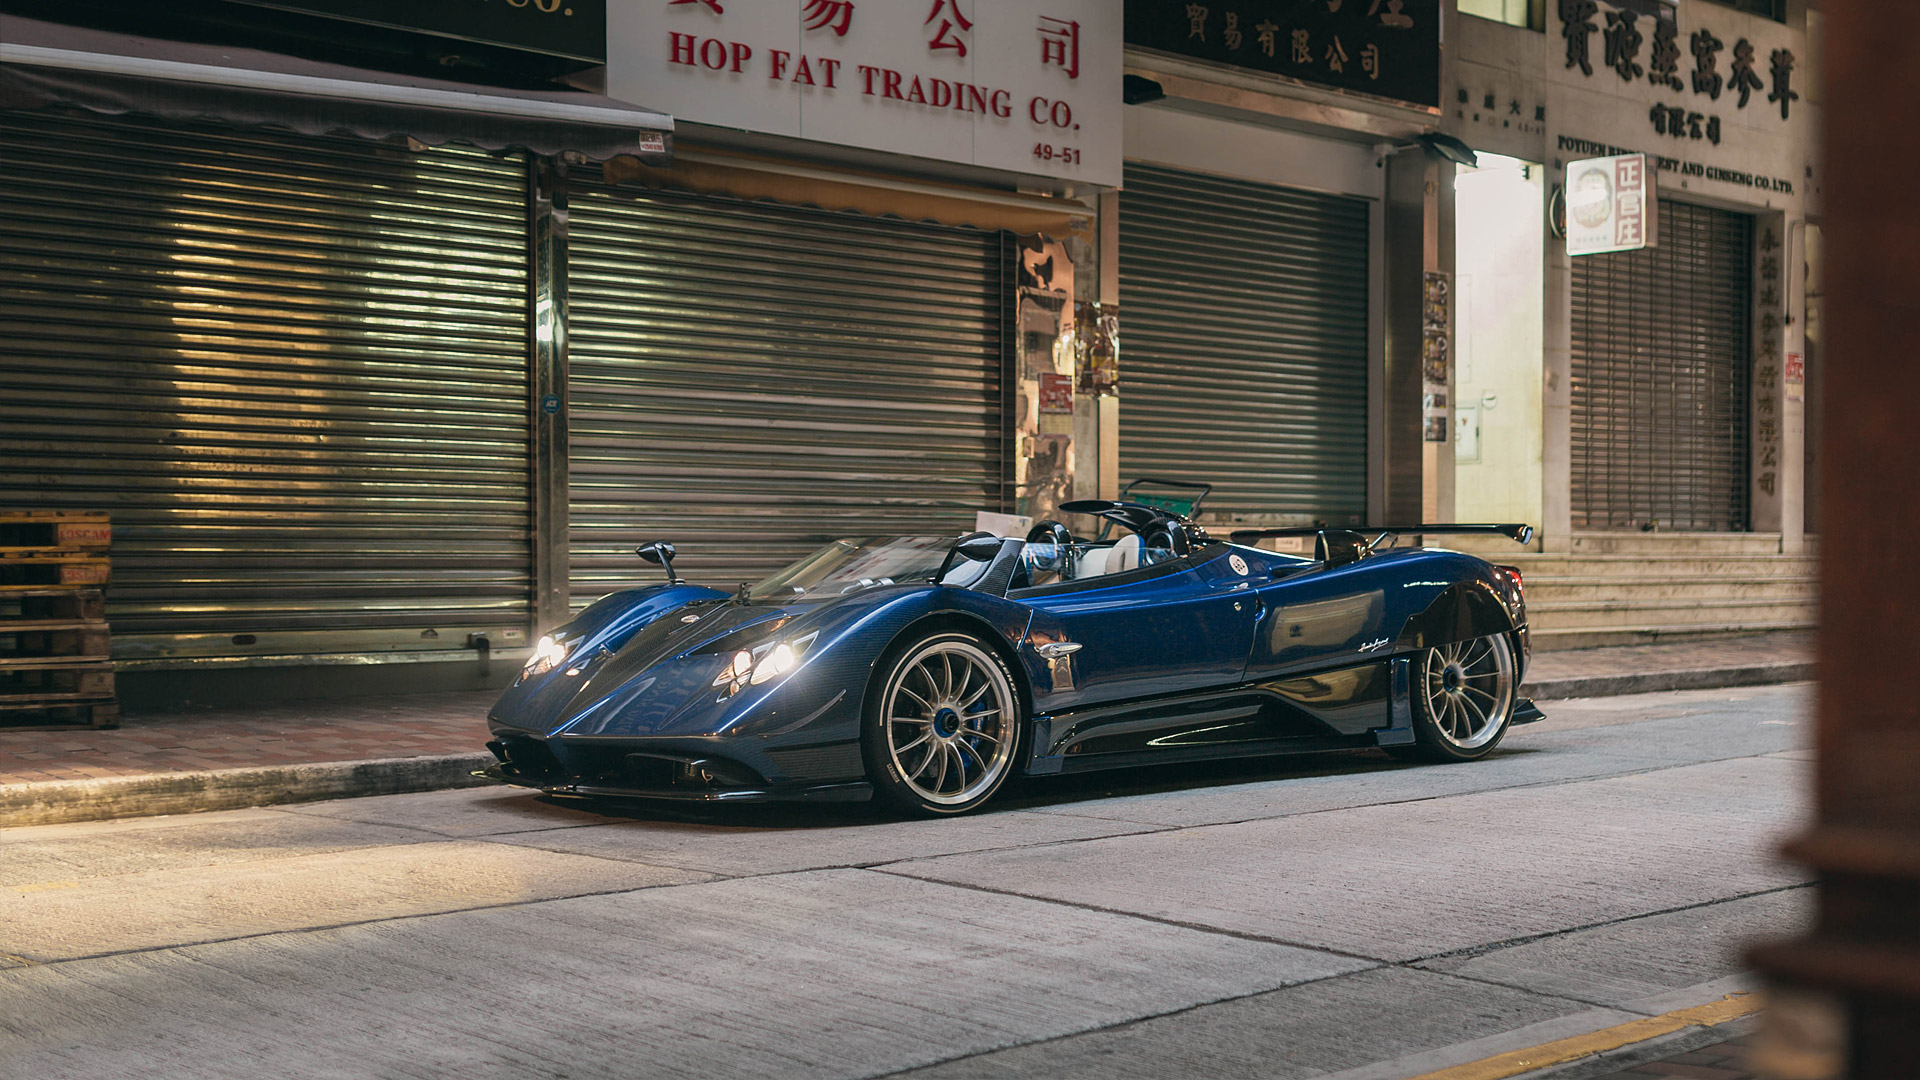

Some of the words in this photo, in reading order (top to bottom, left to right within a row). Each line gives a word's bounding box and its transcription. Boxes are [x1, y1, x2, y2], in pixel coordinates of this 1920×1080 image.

[1186, 3, 1379, 80] 貿易有限公司
[668, 31, 752, 73] HOP
[768, 49, 841, 89] FAT
[858, 64, 1013, 118] TRADING
[1029, 96, 1080, 130] CO.
[1033, 143, 1080, 165] 49-51
[1656, 156, 1679, 173] EST
[1681, 160, 1704, 177] AND
[1706, 166, 1753, 187] GINSENG
[1616, 161, 1642, 245] 正官庄
